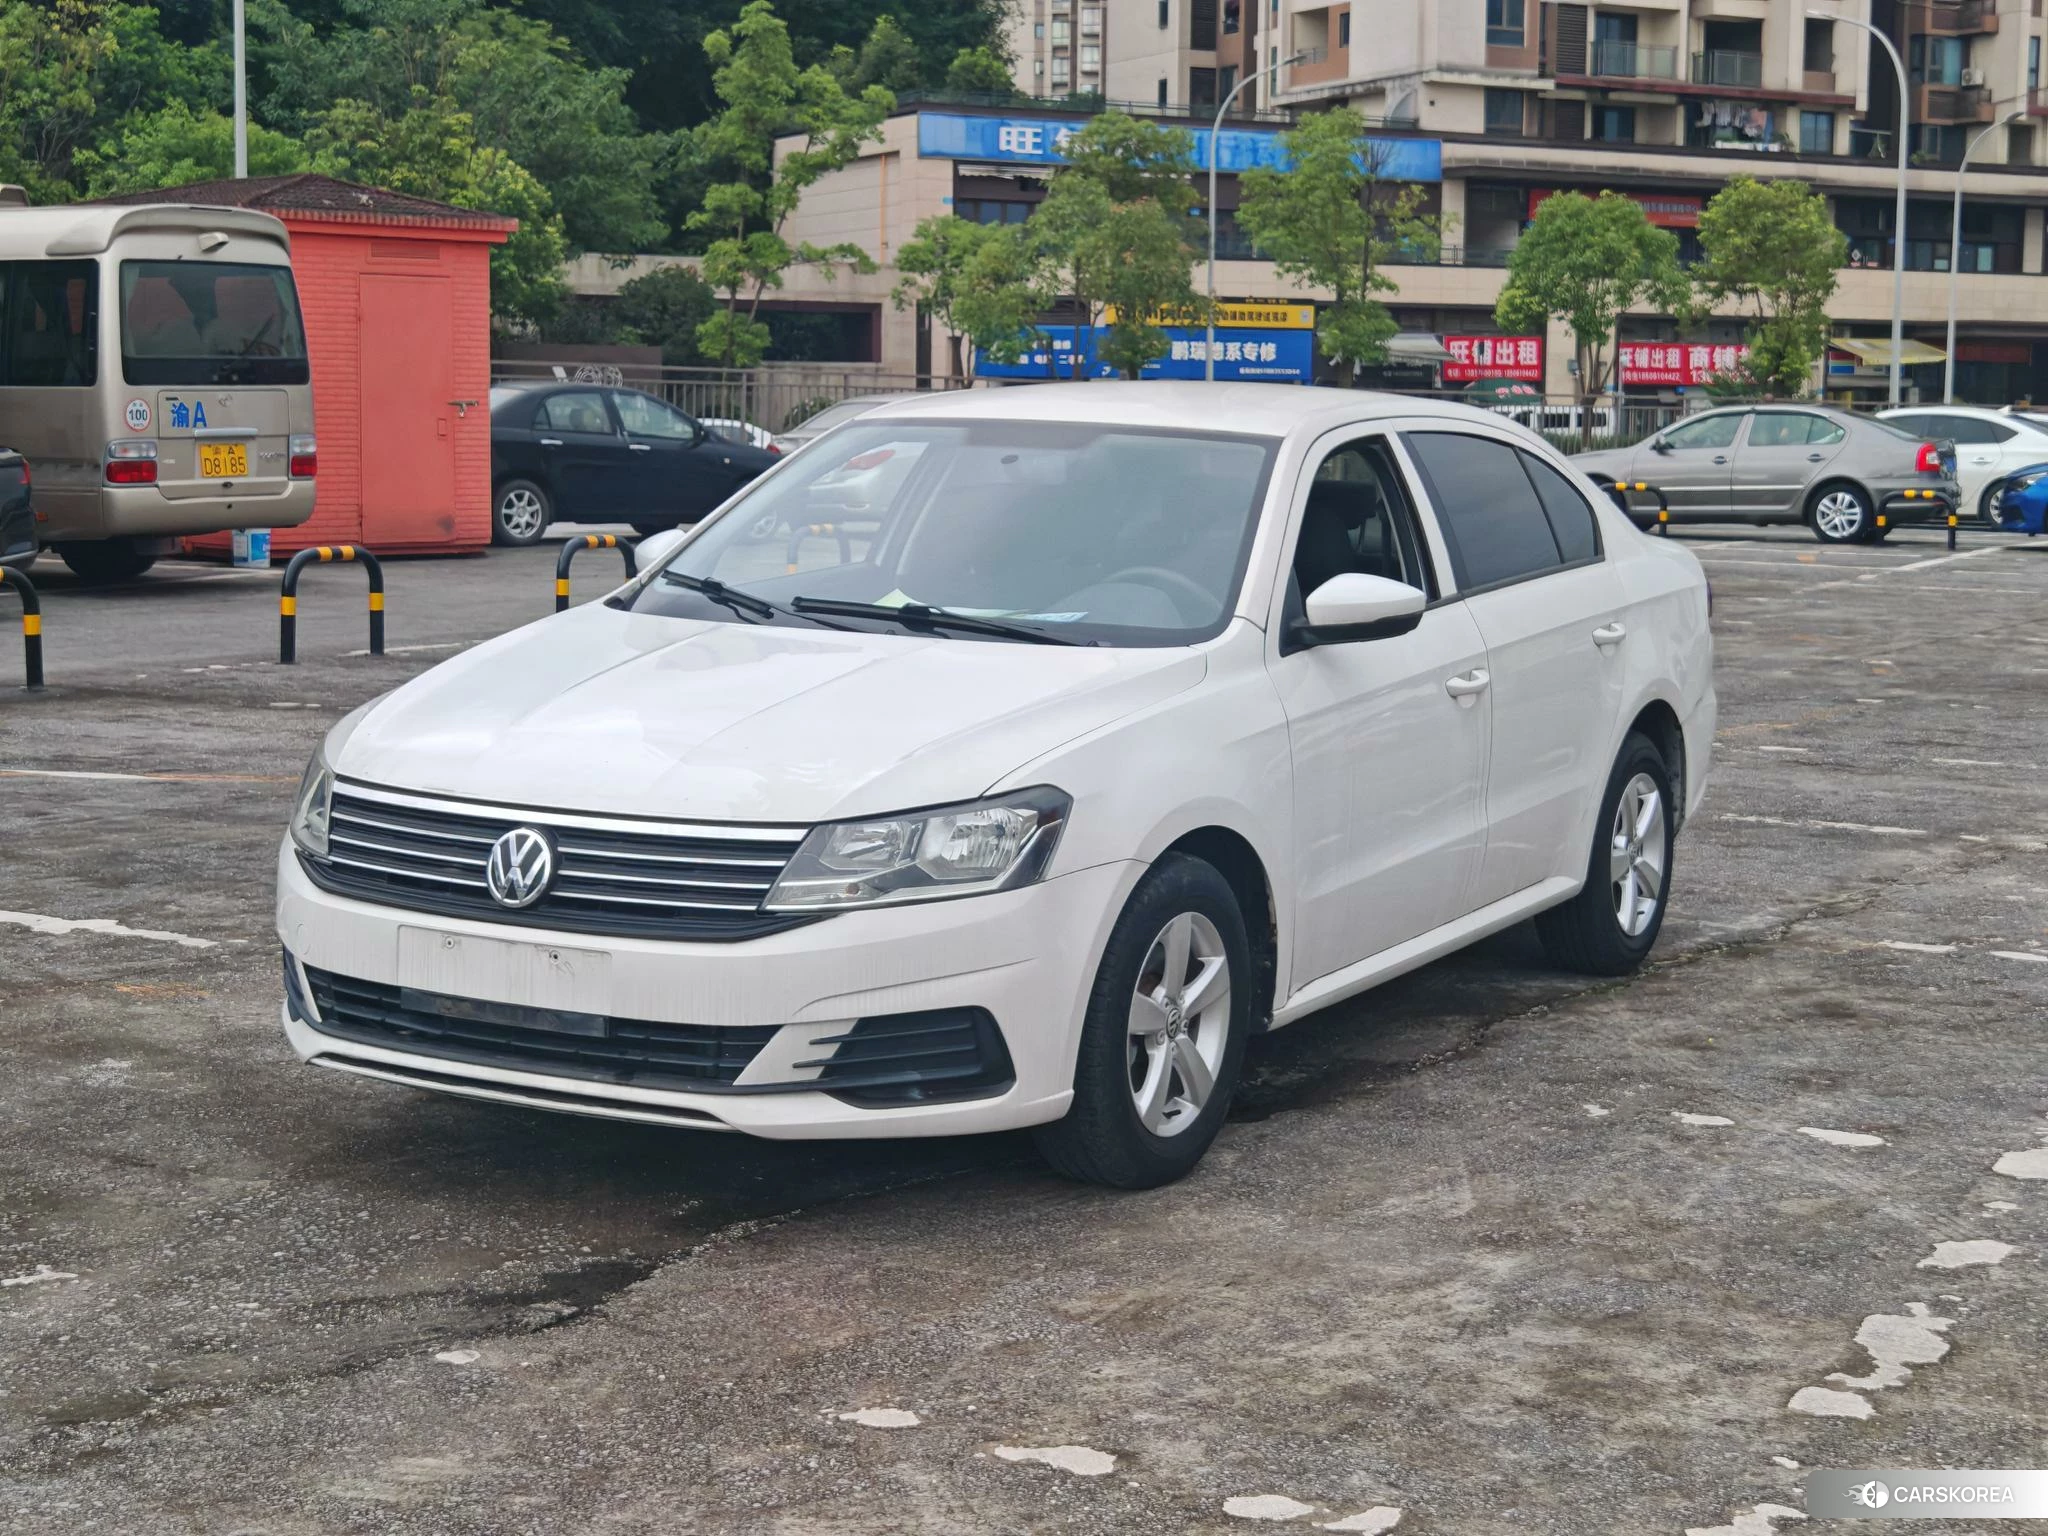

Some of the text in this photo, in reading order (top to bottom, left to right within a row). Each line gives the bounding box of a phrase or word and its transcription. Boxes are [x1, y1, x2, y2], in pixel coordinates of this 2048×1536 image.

[1449, 340, 1539, 365] 旺铺出租
[128, 409, 148, 421] 100
[171, 401, 207, 428] 渝A
[204, 456, 246, 475] D8185
